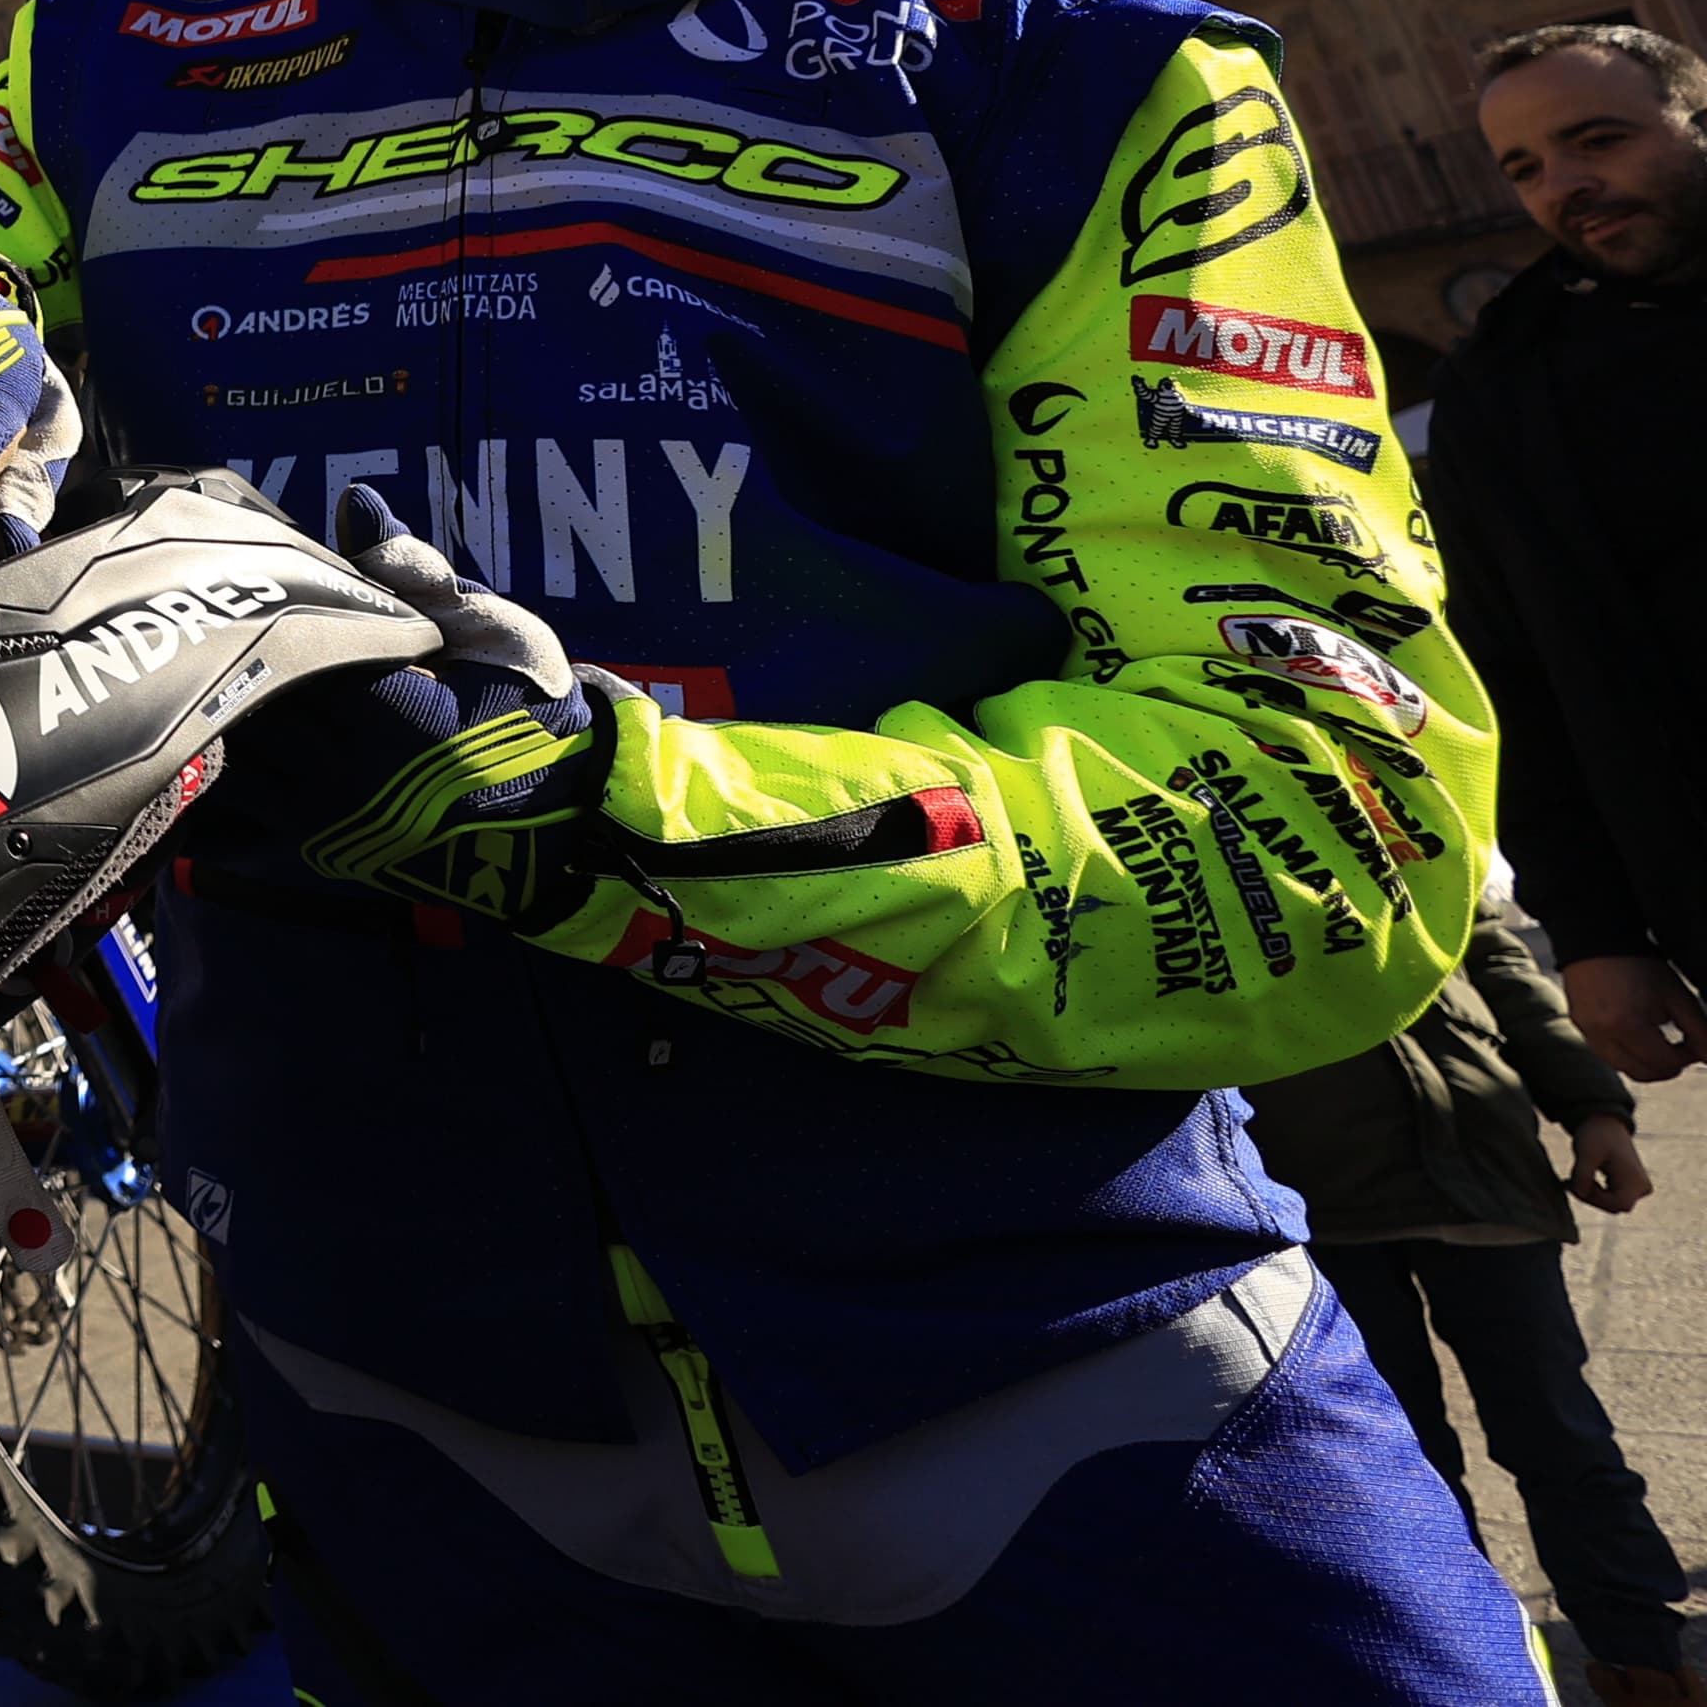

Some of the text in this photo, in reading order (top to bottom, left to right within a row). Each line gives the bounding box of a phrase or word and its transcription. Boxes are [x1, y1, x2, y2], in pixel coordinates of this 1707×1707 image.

[135, 106, 903, 208] SHERCO
[1148, 308, 1356, 387] MOTUL
[1202, 411, 1374, 459] MICHELIN
[1013, 449, 1089, 593] PONT
[1208, 502, 1363, 547] AFAM
[1091, 806, 1204, 998] MUNTADA
[1128, 793, 1236, 994] MECANITZATS
[1189, 749, 1365, 955] SALAMANCA
